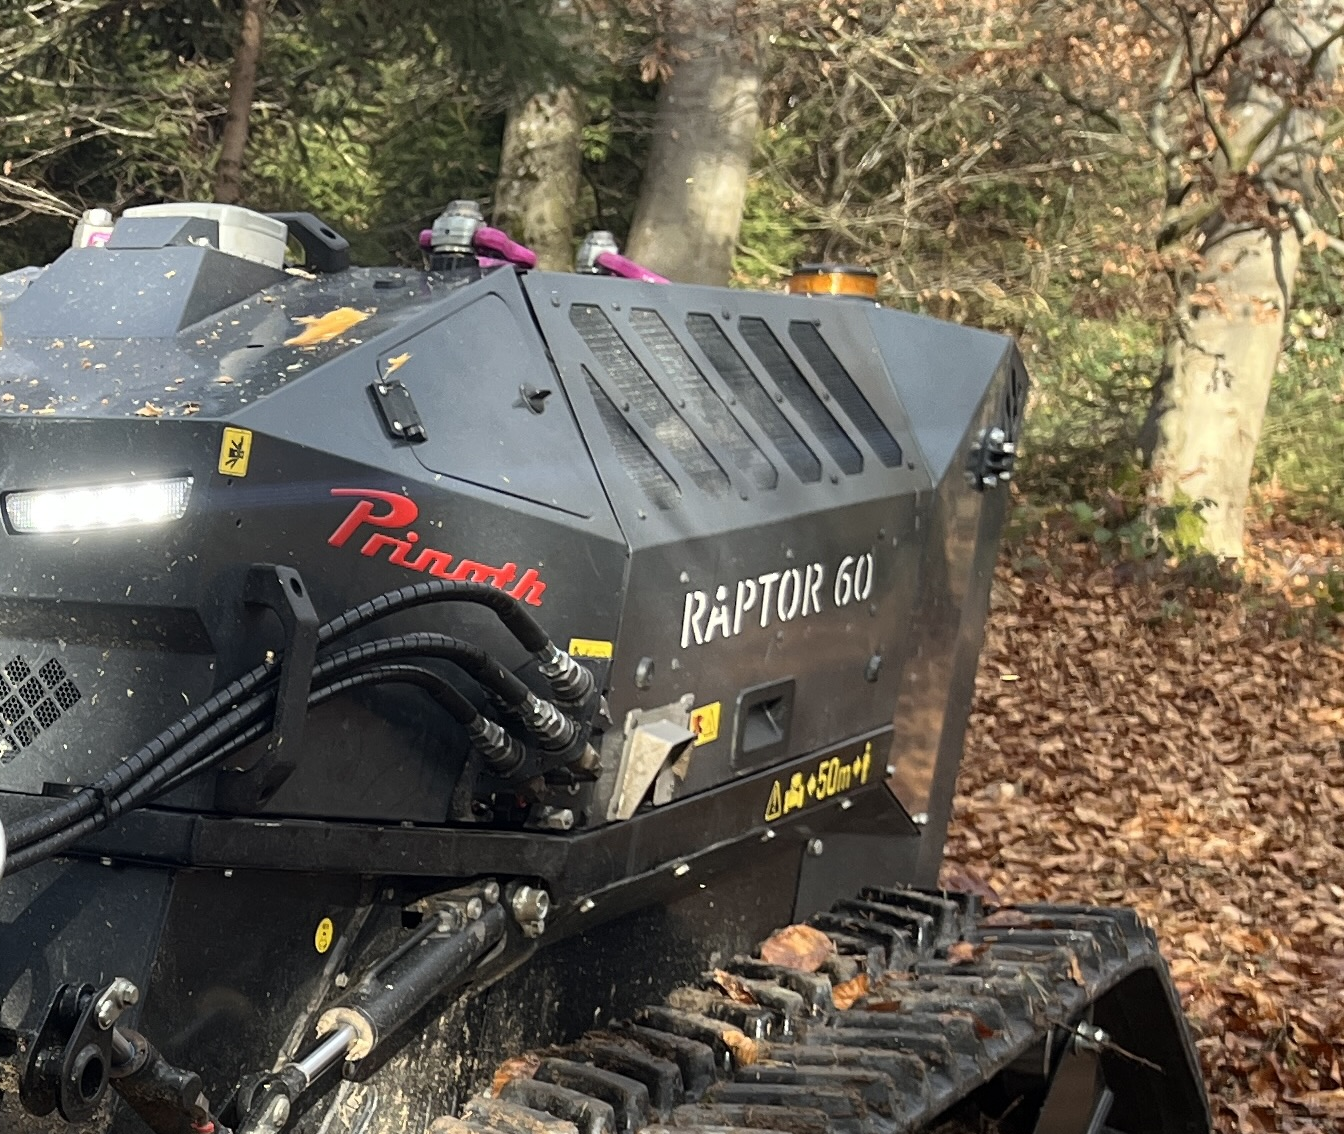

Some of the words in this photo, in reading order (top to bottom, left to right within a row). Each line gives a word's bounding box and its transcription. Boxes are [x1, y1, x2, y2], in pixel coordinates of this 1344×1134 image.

[327, 488, 547, 607] Prinoth
[680, 563, 824, 649] RAPTOR
[834, 553, 874, 607] 60
[816, 757, 851, 800] 50m
